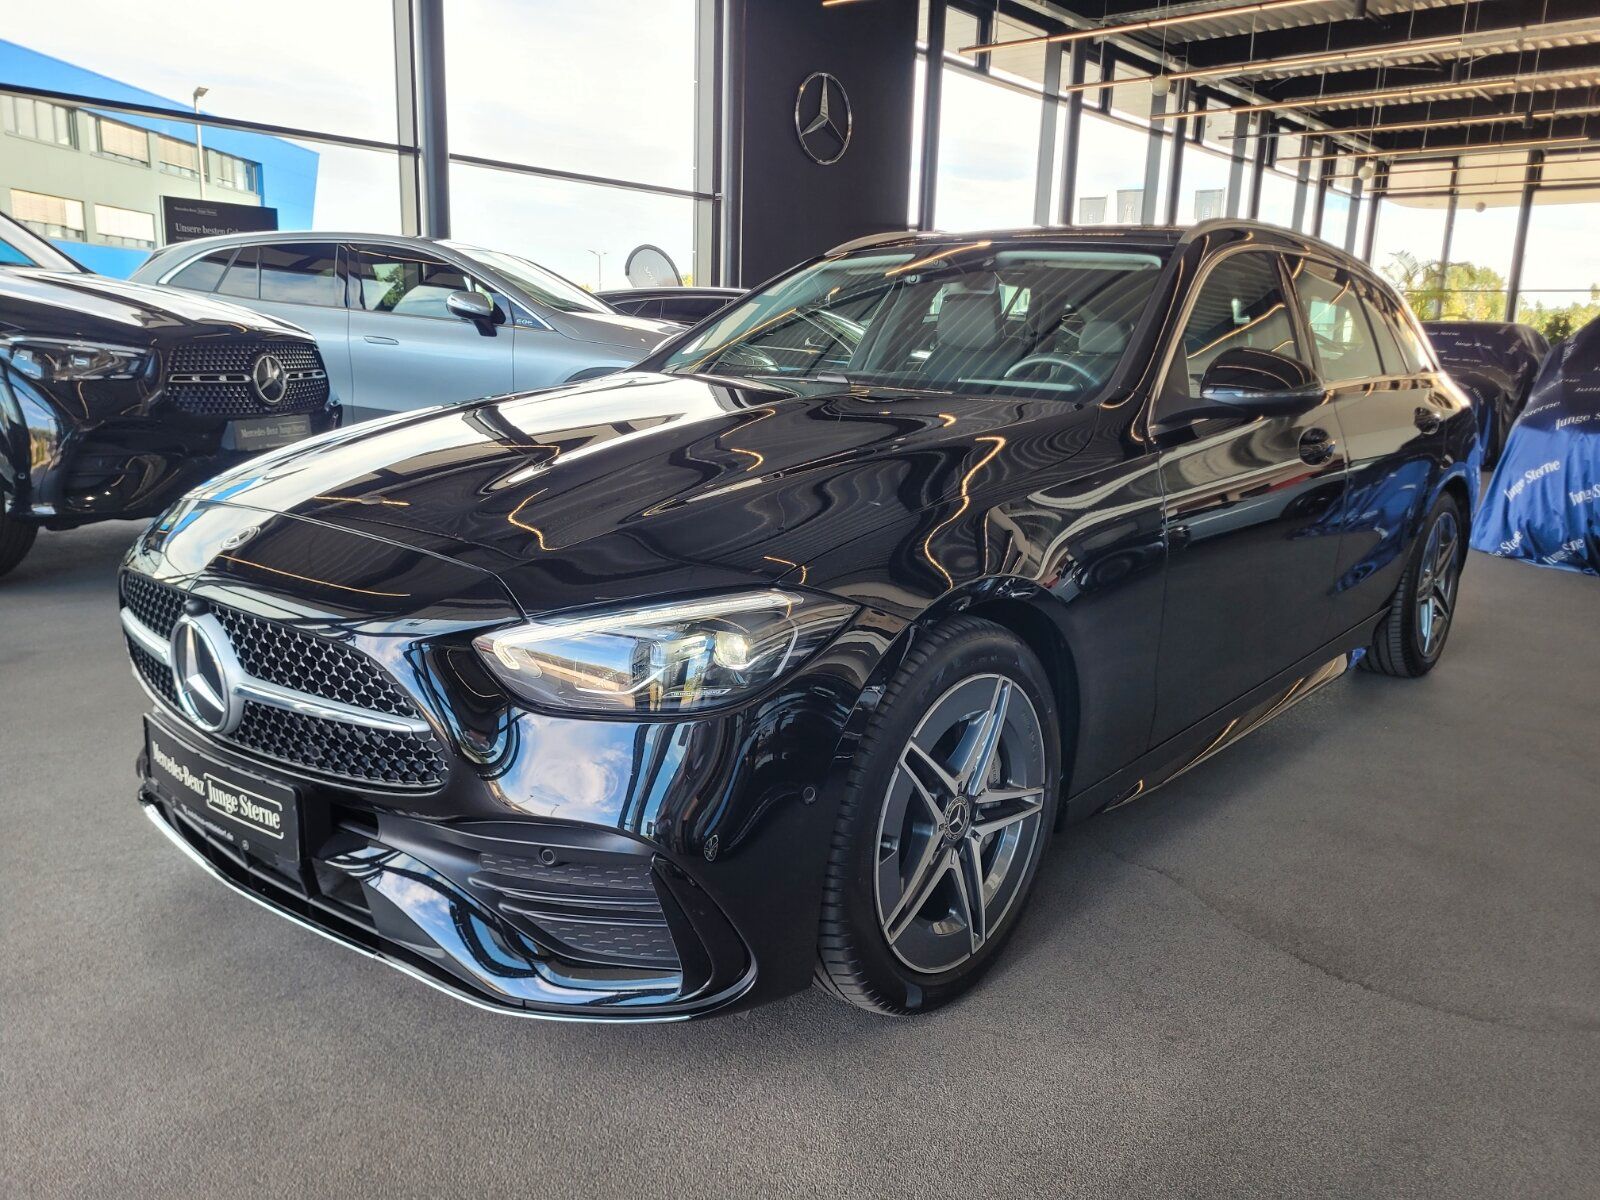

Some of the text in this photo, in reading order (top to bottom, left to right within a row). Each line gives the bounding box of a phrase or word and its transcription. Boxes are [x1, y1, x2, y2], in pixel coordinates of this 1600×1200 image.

[175, 222, 202, 234] Unsere
[202, 225, 226, 236] besten
[1555, 414, 1592, 431] Junge
[1524, 460, 1561, 485] Sterne
[152, 740, 206, 797] Mercedes-Benz
[207, 779, 239, 814] Junge
[239, 794, 281, 830] Sterne
